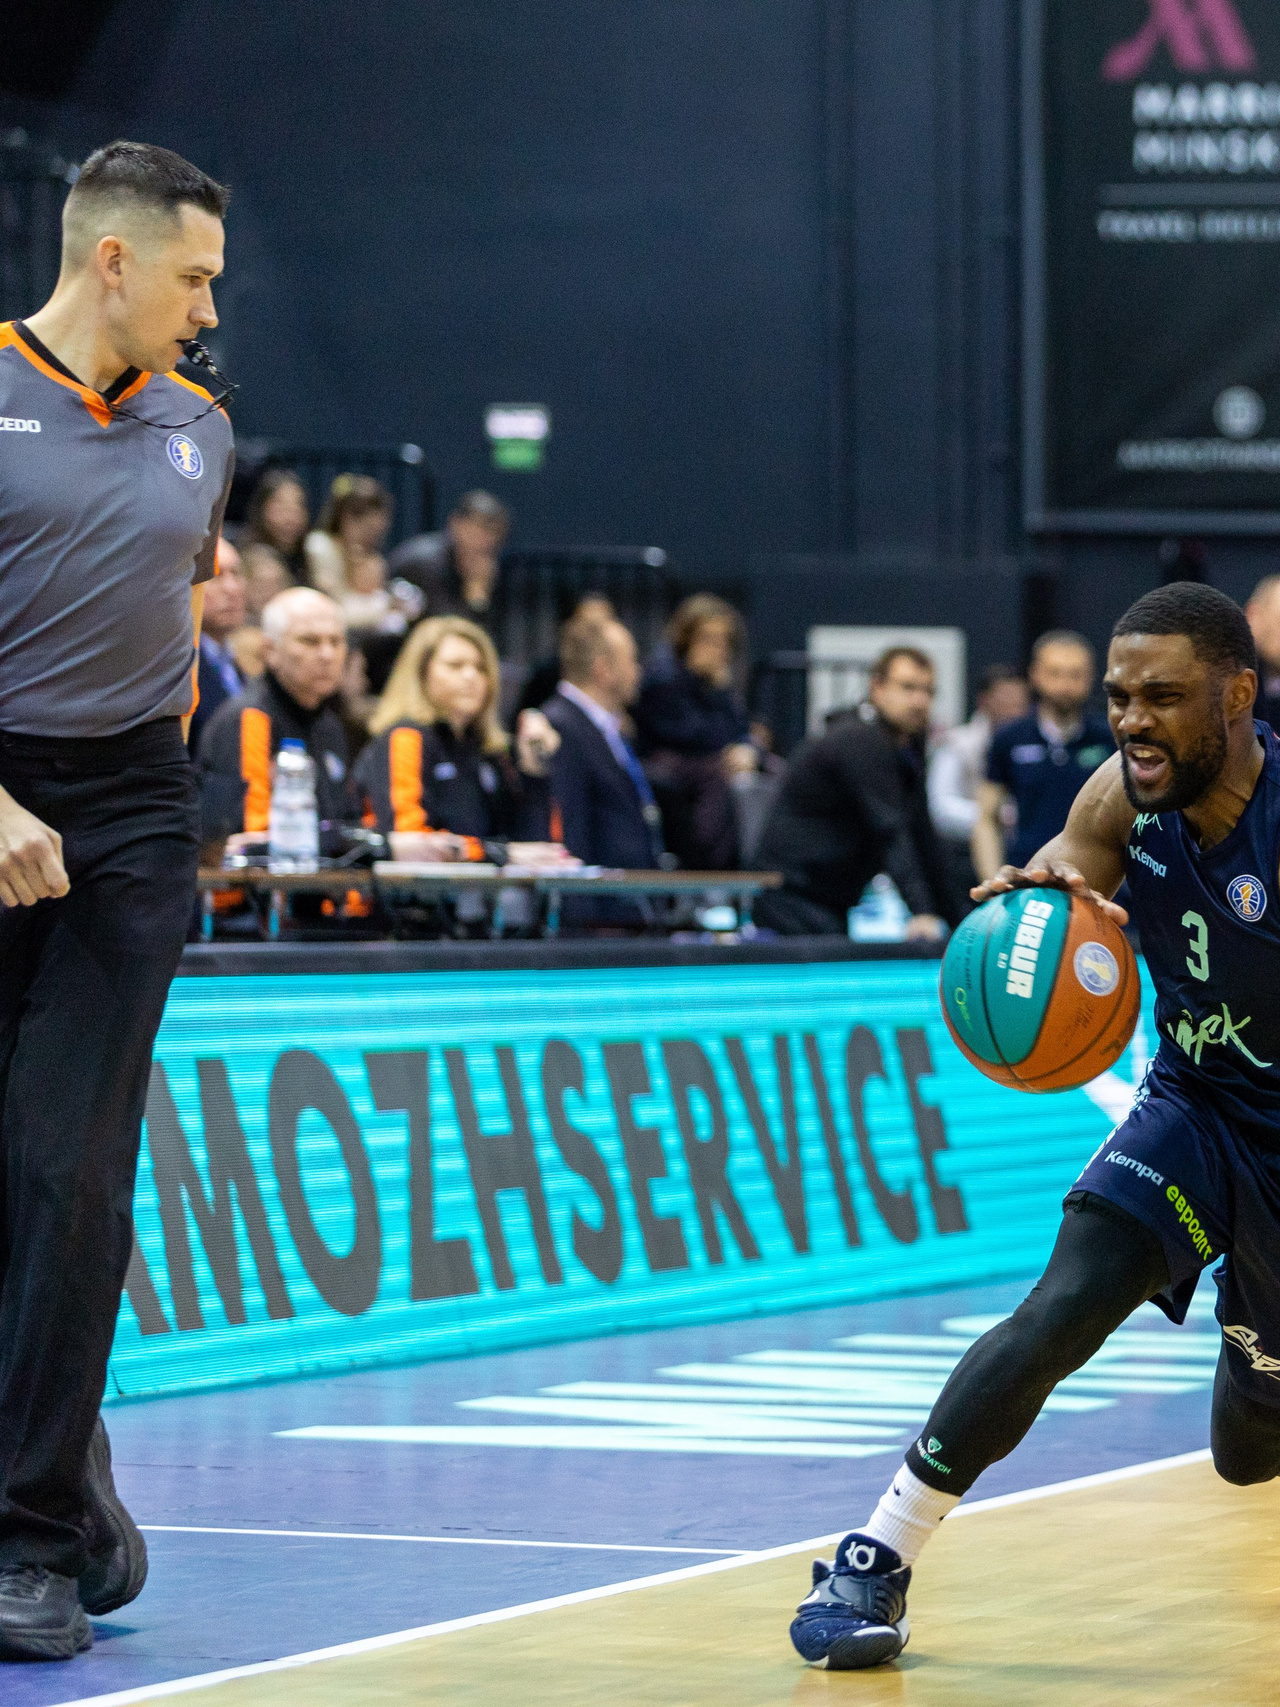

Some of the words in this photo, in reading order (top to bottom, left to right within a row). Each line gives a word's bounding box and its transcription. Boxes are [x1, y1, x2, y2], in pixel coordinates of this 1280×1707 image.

[1128, 844, 1167, 878] Kempa
[1005, 898, 1055, 999] SIBUR
[1181, 909, 1210, 982] 3
[1104, 1150, 1165, 1186] Kempa
[1166, 1185, 1213, 1261] евроопт
